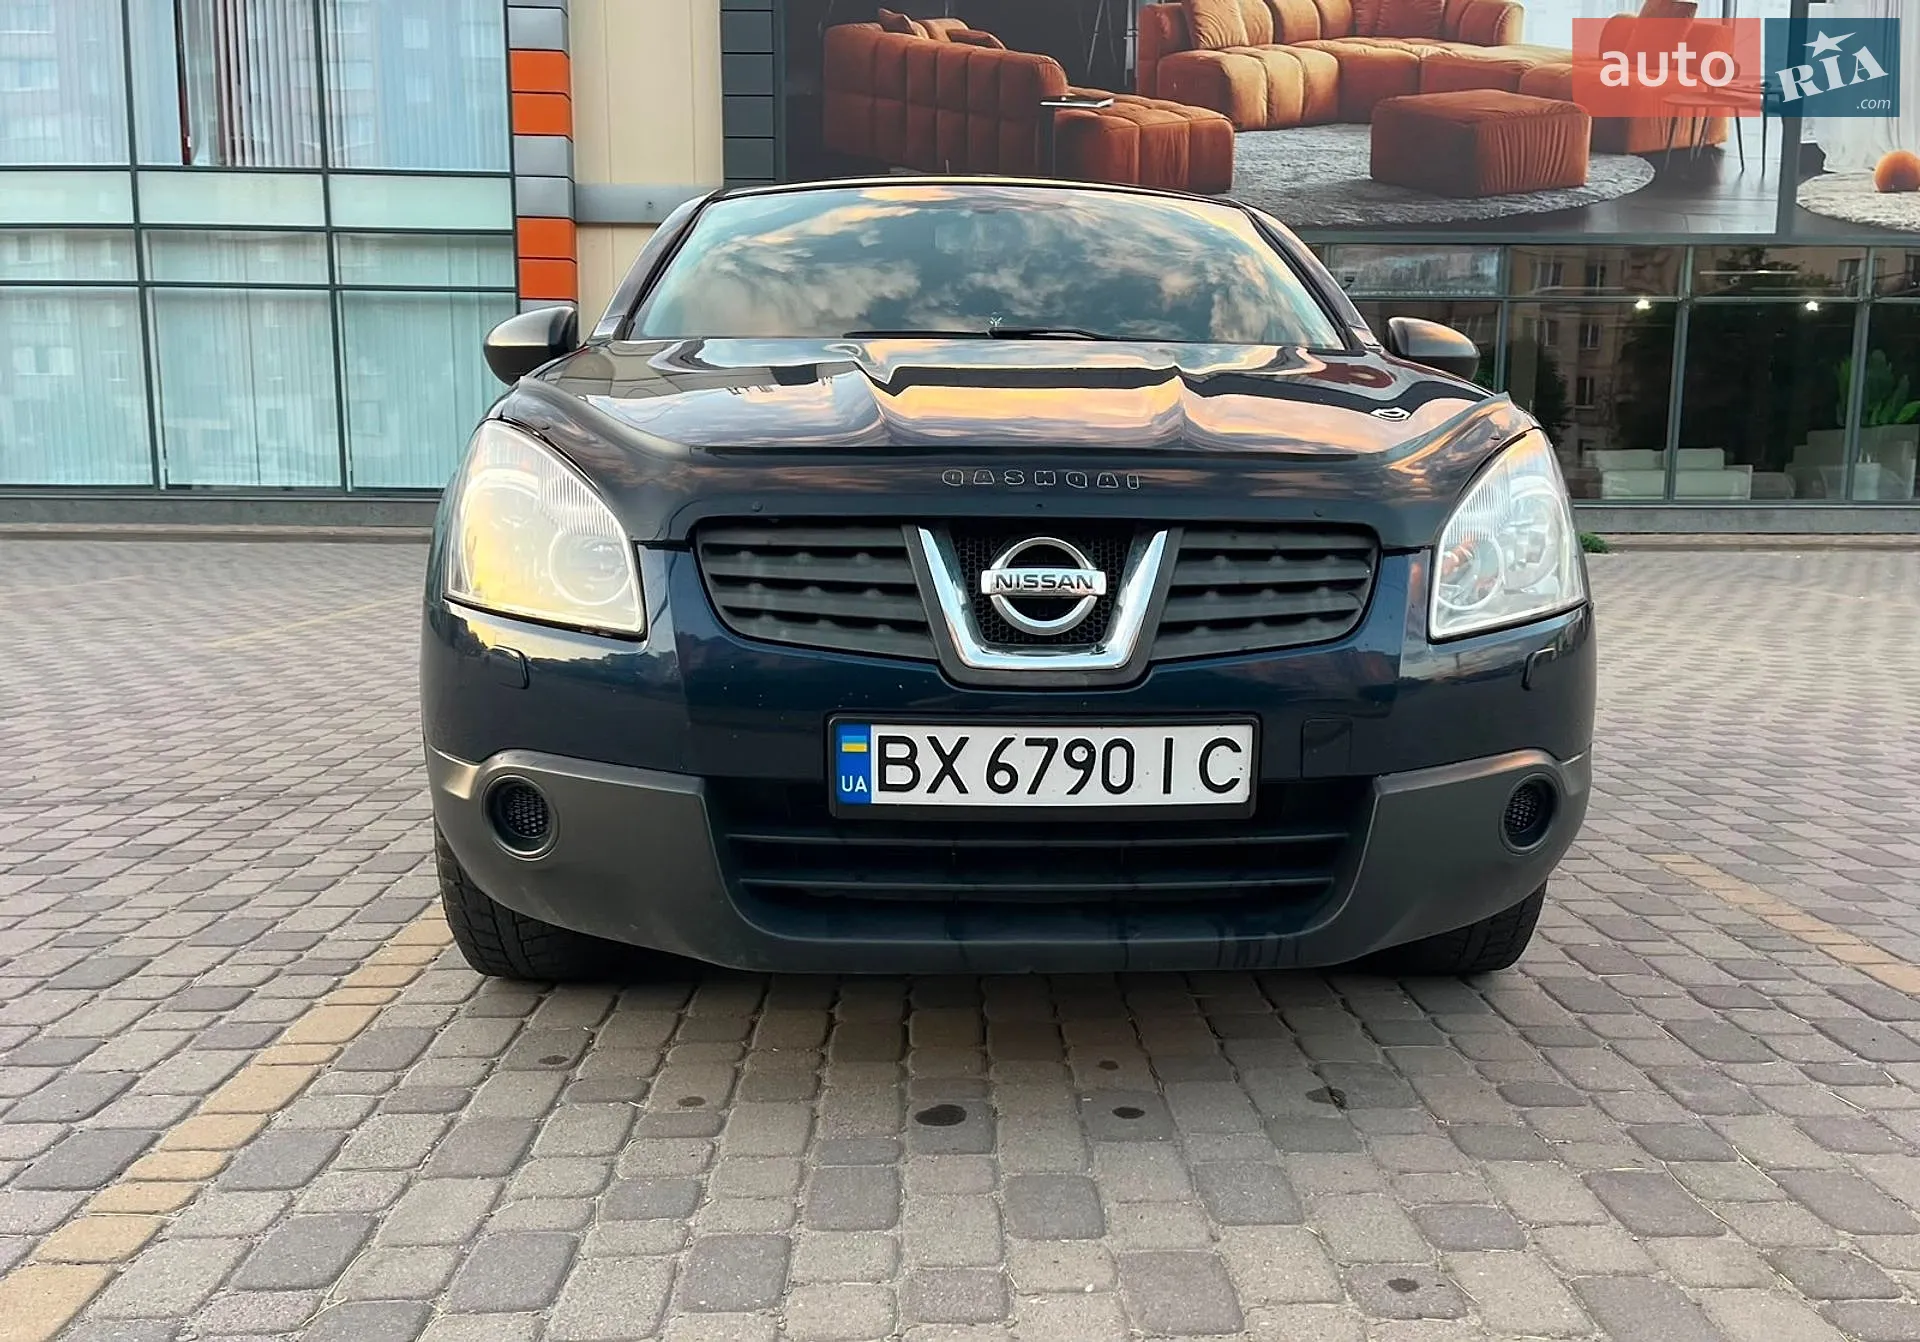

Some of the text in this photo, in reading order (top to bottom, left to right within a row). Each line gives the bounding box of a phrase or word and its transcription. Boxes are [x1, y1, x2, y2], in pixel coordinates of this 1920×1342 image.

[941, 469, 1141, 490] QASHQAI
[995, 573, 1094, 590] NISSAN
[876, 734, 970, 795] BX
[985, 736, 1136, 796] 6790
[841, 774, 868, 793] UA
